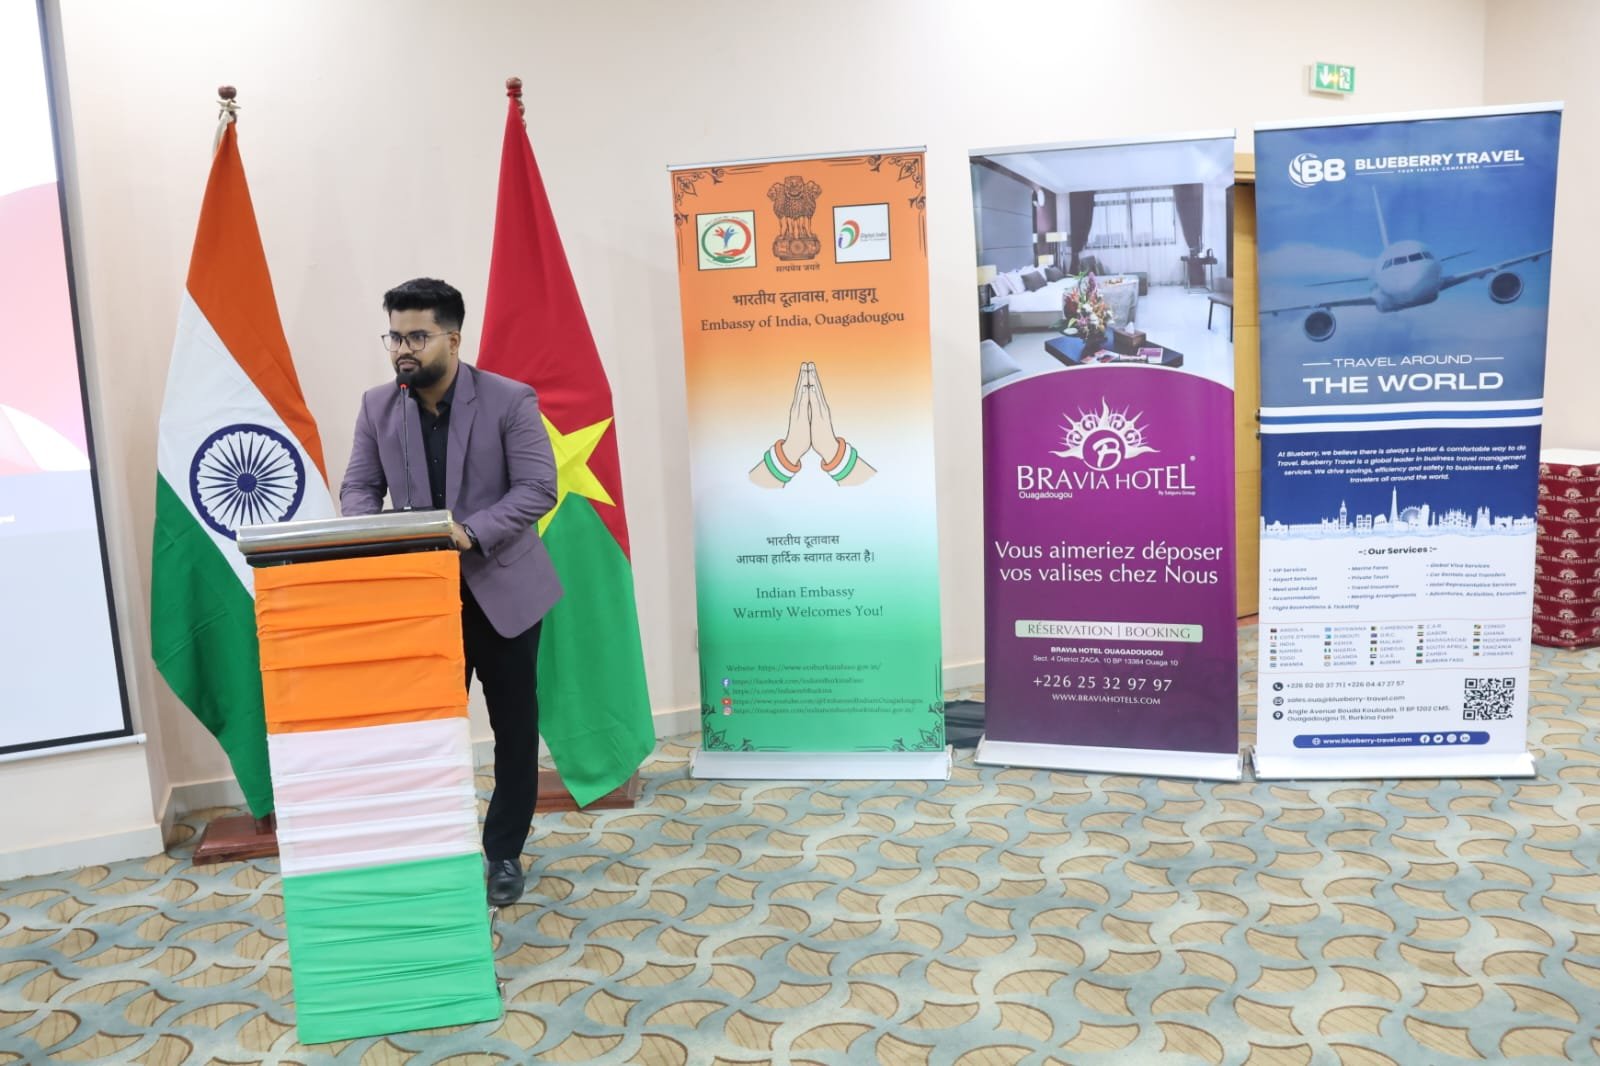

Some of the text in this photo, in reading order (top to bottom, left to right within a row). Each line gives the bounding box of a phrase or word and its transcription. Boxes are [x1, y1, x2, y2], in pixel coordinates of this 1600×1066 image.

[1355, 150, 1524, 170] BLUEBERRY TRAVEL
[733, 290, 776, 306] भारतीय
[701, 311, 904, 331] Embassy of India, Ouagadougou
[1333, 354, 1473, 368] TRAVEL AROUND
[1303, 372, 1504, 394] THE WORLD
[1301, 459, 1332, 467] Blueberry
[1017, 464, 1195, 490] BRAVIA HOTEL
[1018, 490, 1072, 500] Ouagadougou
[766, 533, 840, 548] भारतीय दूतावास
[995, 540, 1223, 566] Vous aimeriez déposer
[1388, 546, 1428, 554] Services
[736, 554, 768, 564] आपका
[803, 553, 832, 563] स्वागत
[836, 552, 861, 562] करता
[1000, 563, 1218, 584] vos valises chez Nous
[756, 586, 855, 600] Indian Embassy
[733, 604, 883, 621] Warmly Welcomes You!
[1028, 622, 1191, 639] RÉSERVATION BOOKING
[1145, 659, 1168, 667] Ouaga
[1033, 674, 1173, 692] +226 25 32 97 97
[1052, 694, 1161, 705] WWW.BRAVIAHOTELS.COM
[1323, 736, 1412, 745] www.blueberry-travel.com
